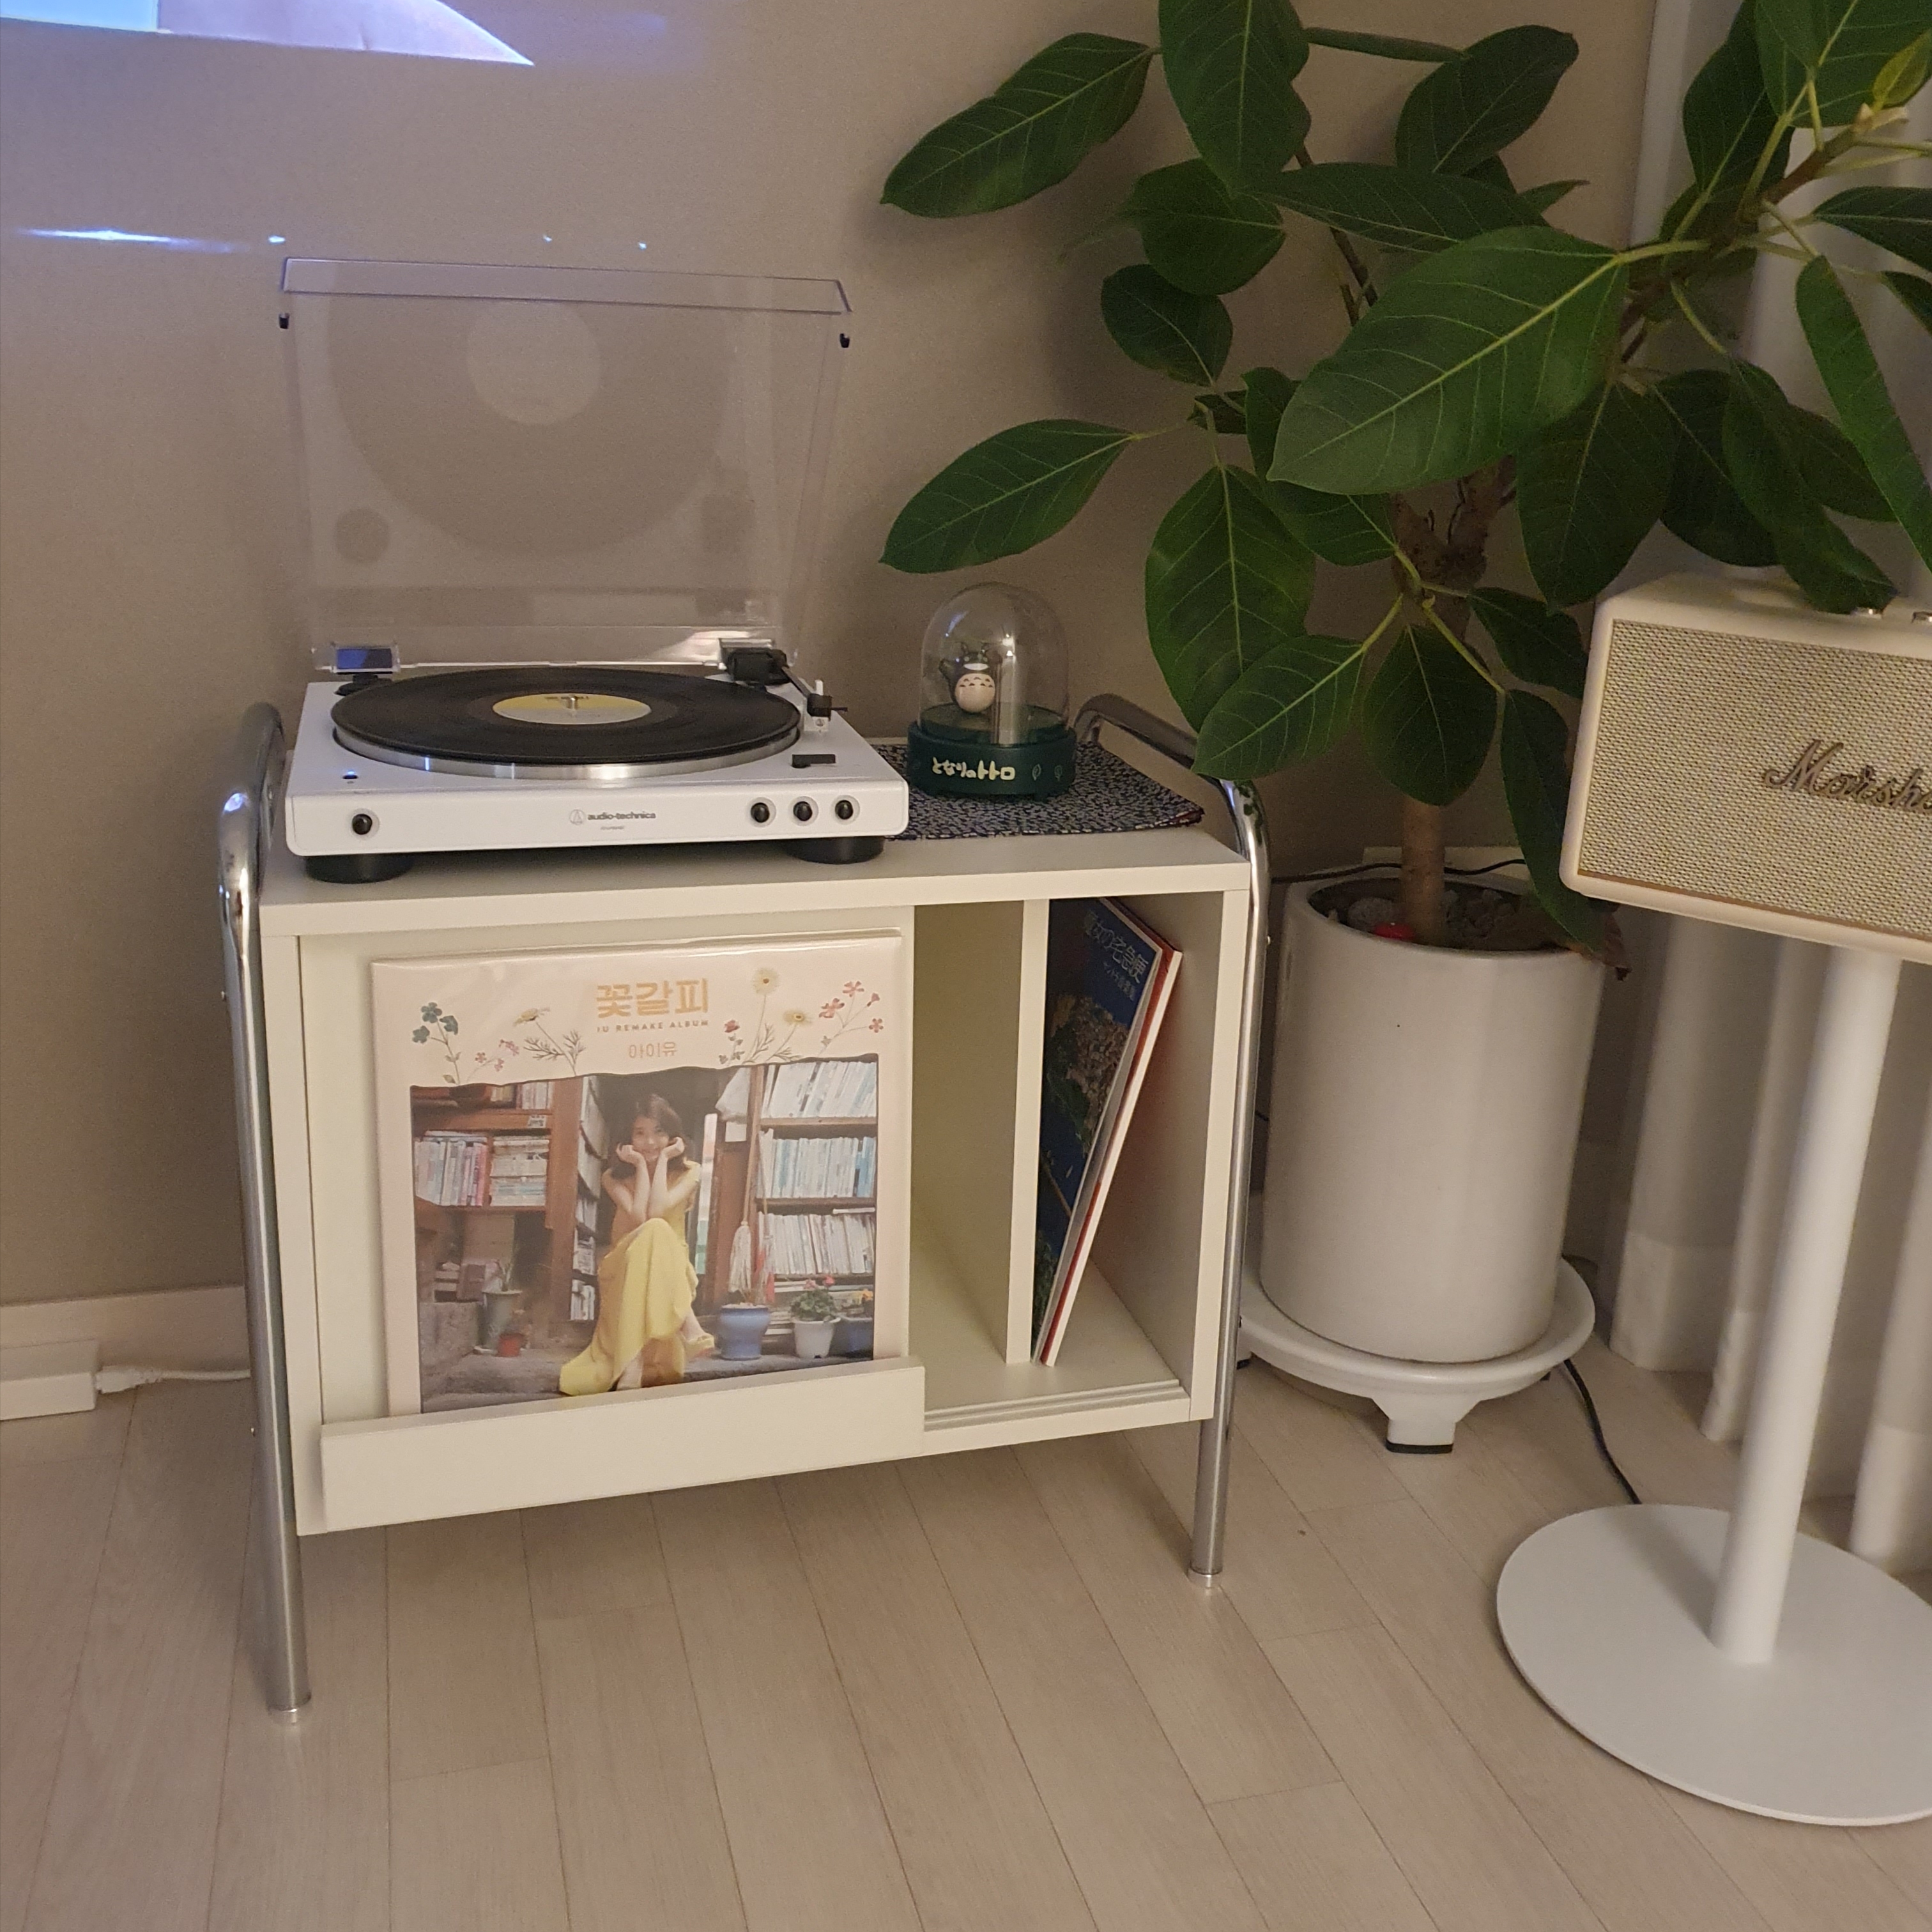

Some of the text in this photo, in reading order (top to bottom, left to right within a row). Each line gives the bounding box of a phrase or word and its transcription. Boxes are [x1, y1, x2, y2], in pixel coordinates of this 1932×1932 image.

[587, 811, 656, 820] audio-technica
[596, 977, 709, 1018] 꽃갈피
[615, 1022, 664, 1032] REMAKE
[670, 1020, 709, 1028] ALBUM
[629, 1041, 678, 1059] 아이유
